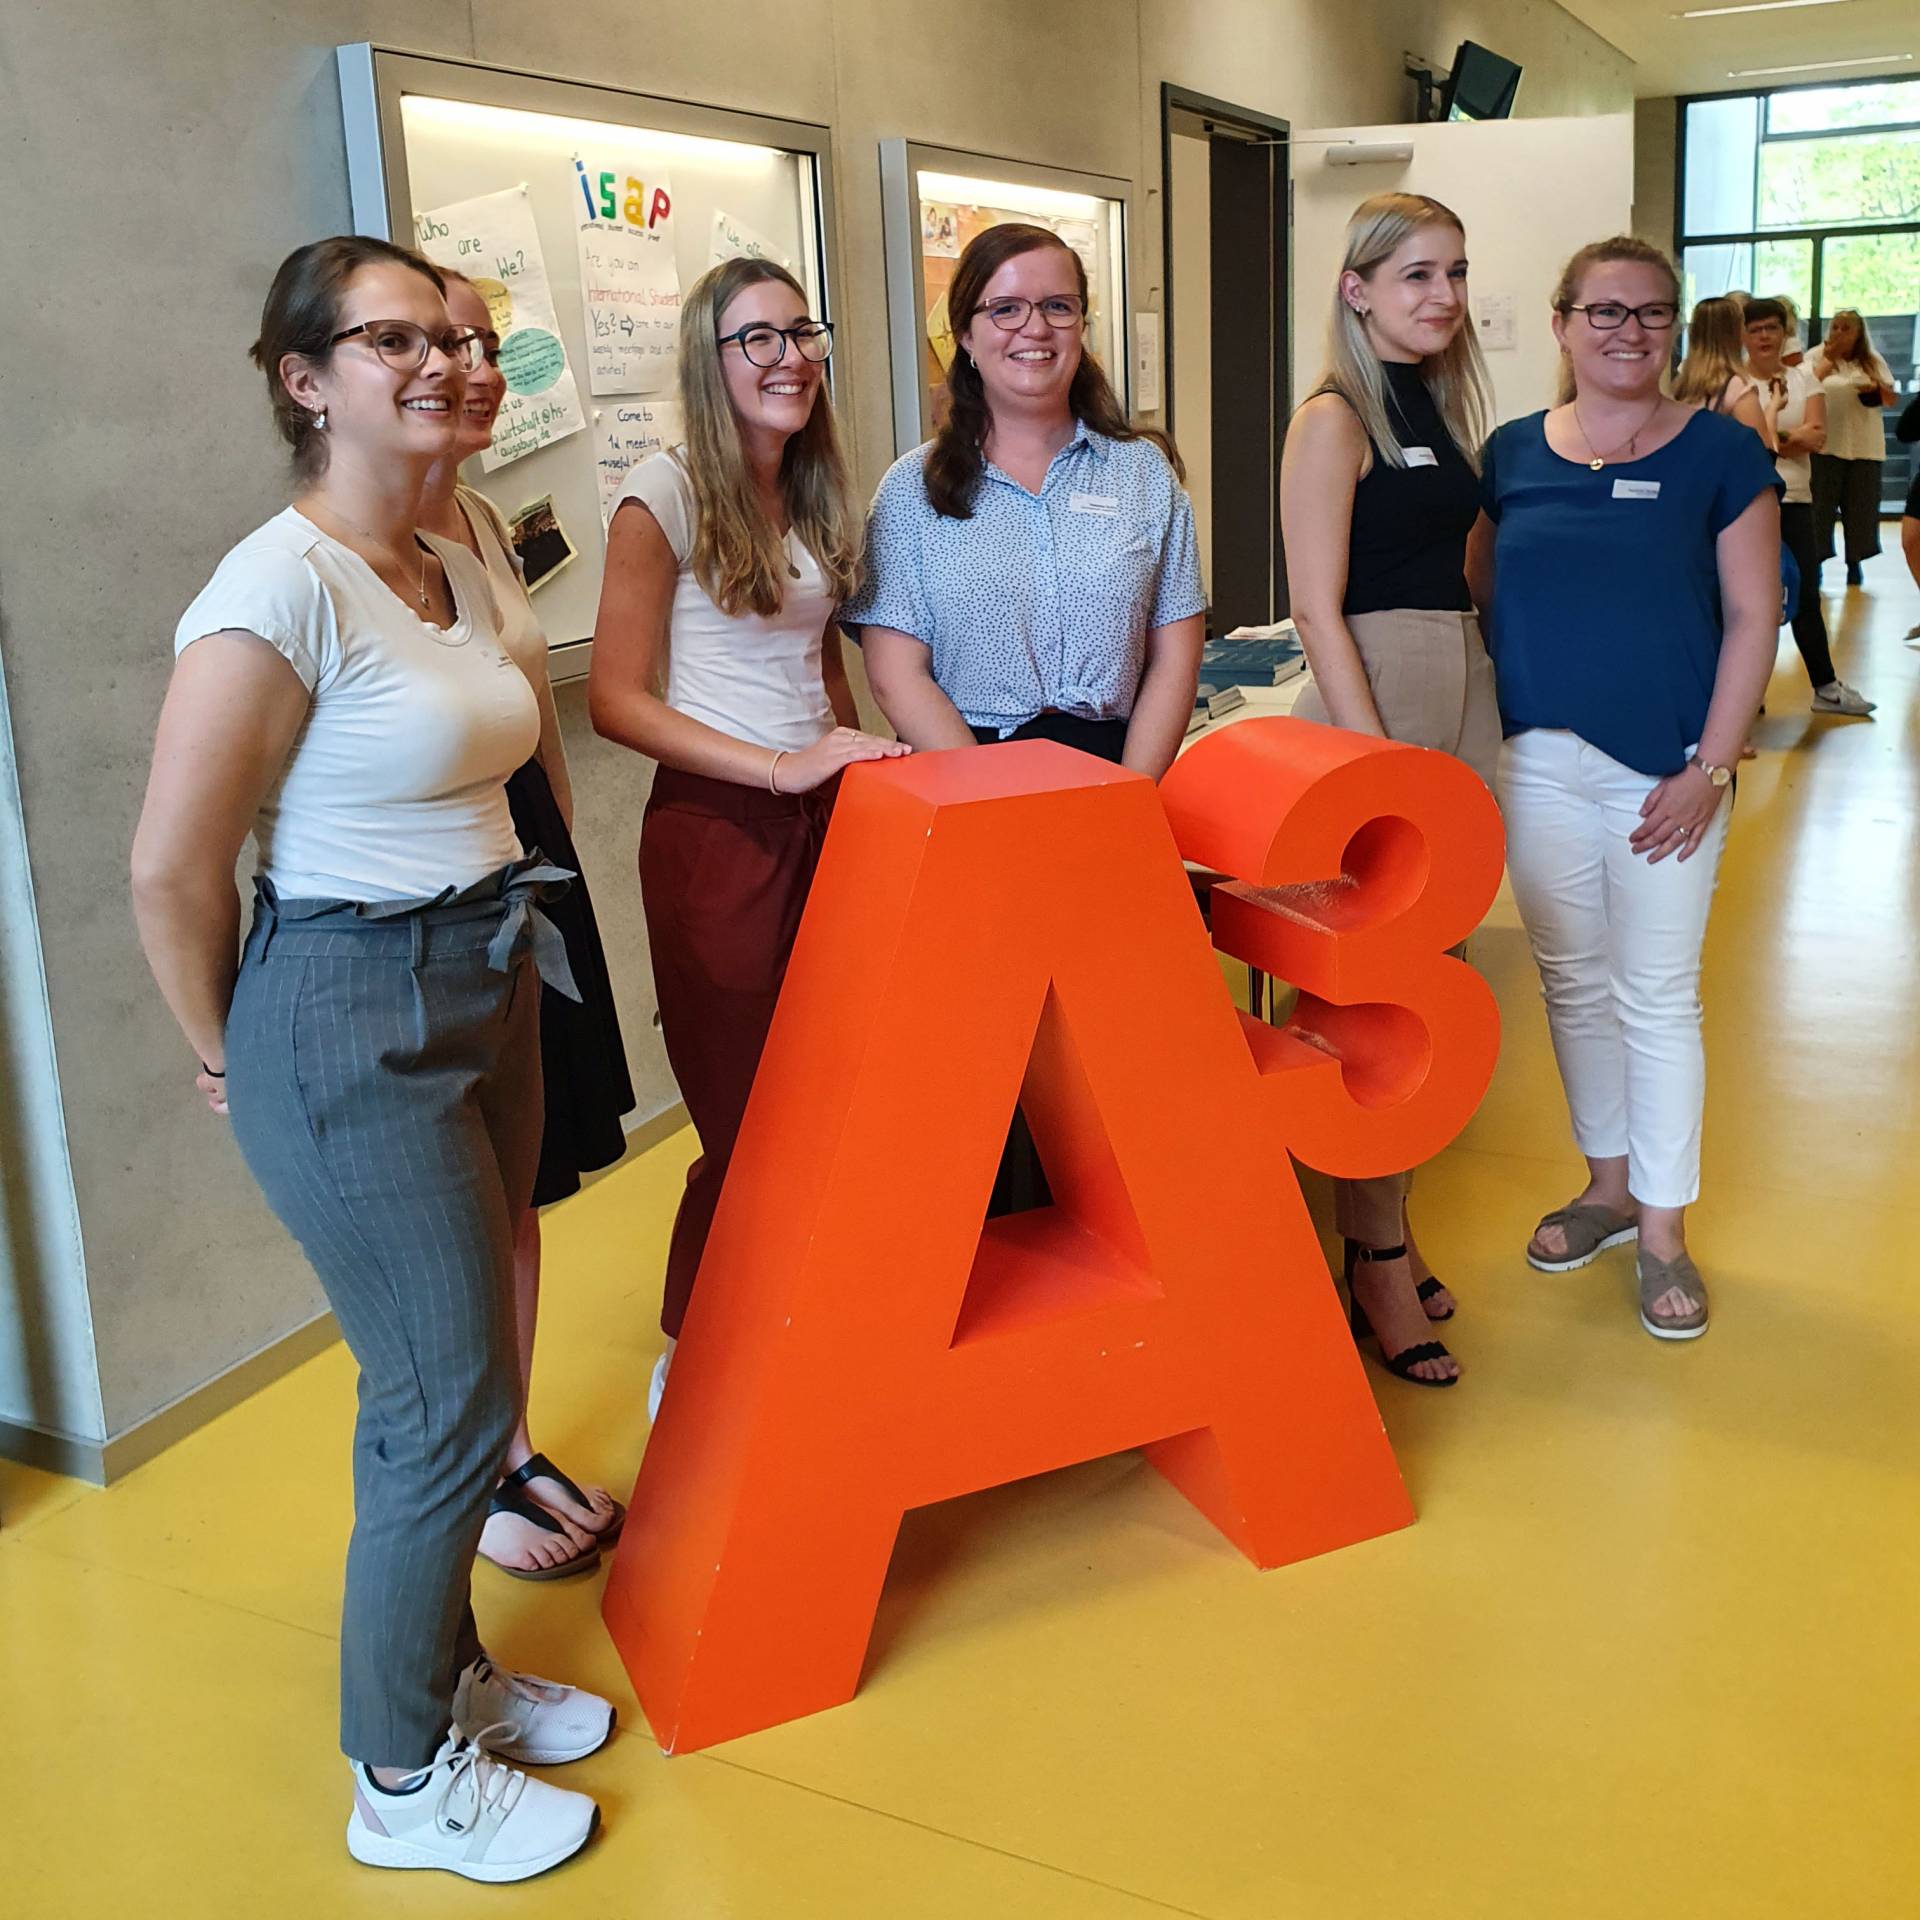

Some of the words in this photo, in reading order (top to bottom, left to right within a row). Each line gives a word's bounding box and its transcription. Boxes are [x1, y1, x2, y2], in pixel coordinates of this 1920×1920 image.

[575, 160, 671, 229] isap
[417, 215, 449, 242] Who
[457, 237, 482, 256] are
[496, 249, 526, 279] We?
[591, 309, 617, 338] Yes?
[617, 408, 641, 422] Come
[643, 406, 654, 421] to
